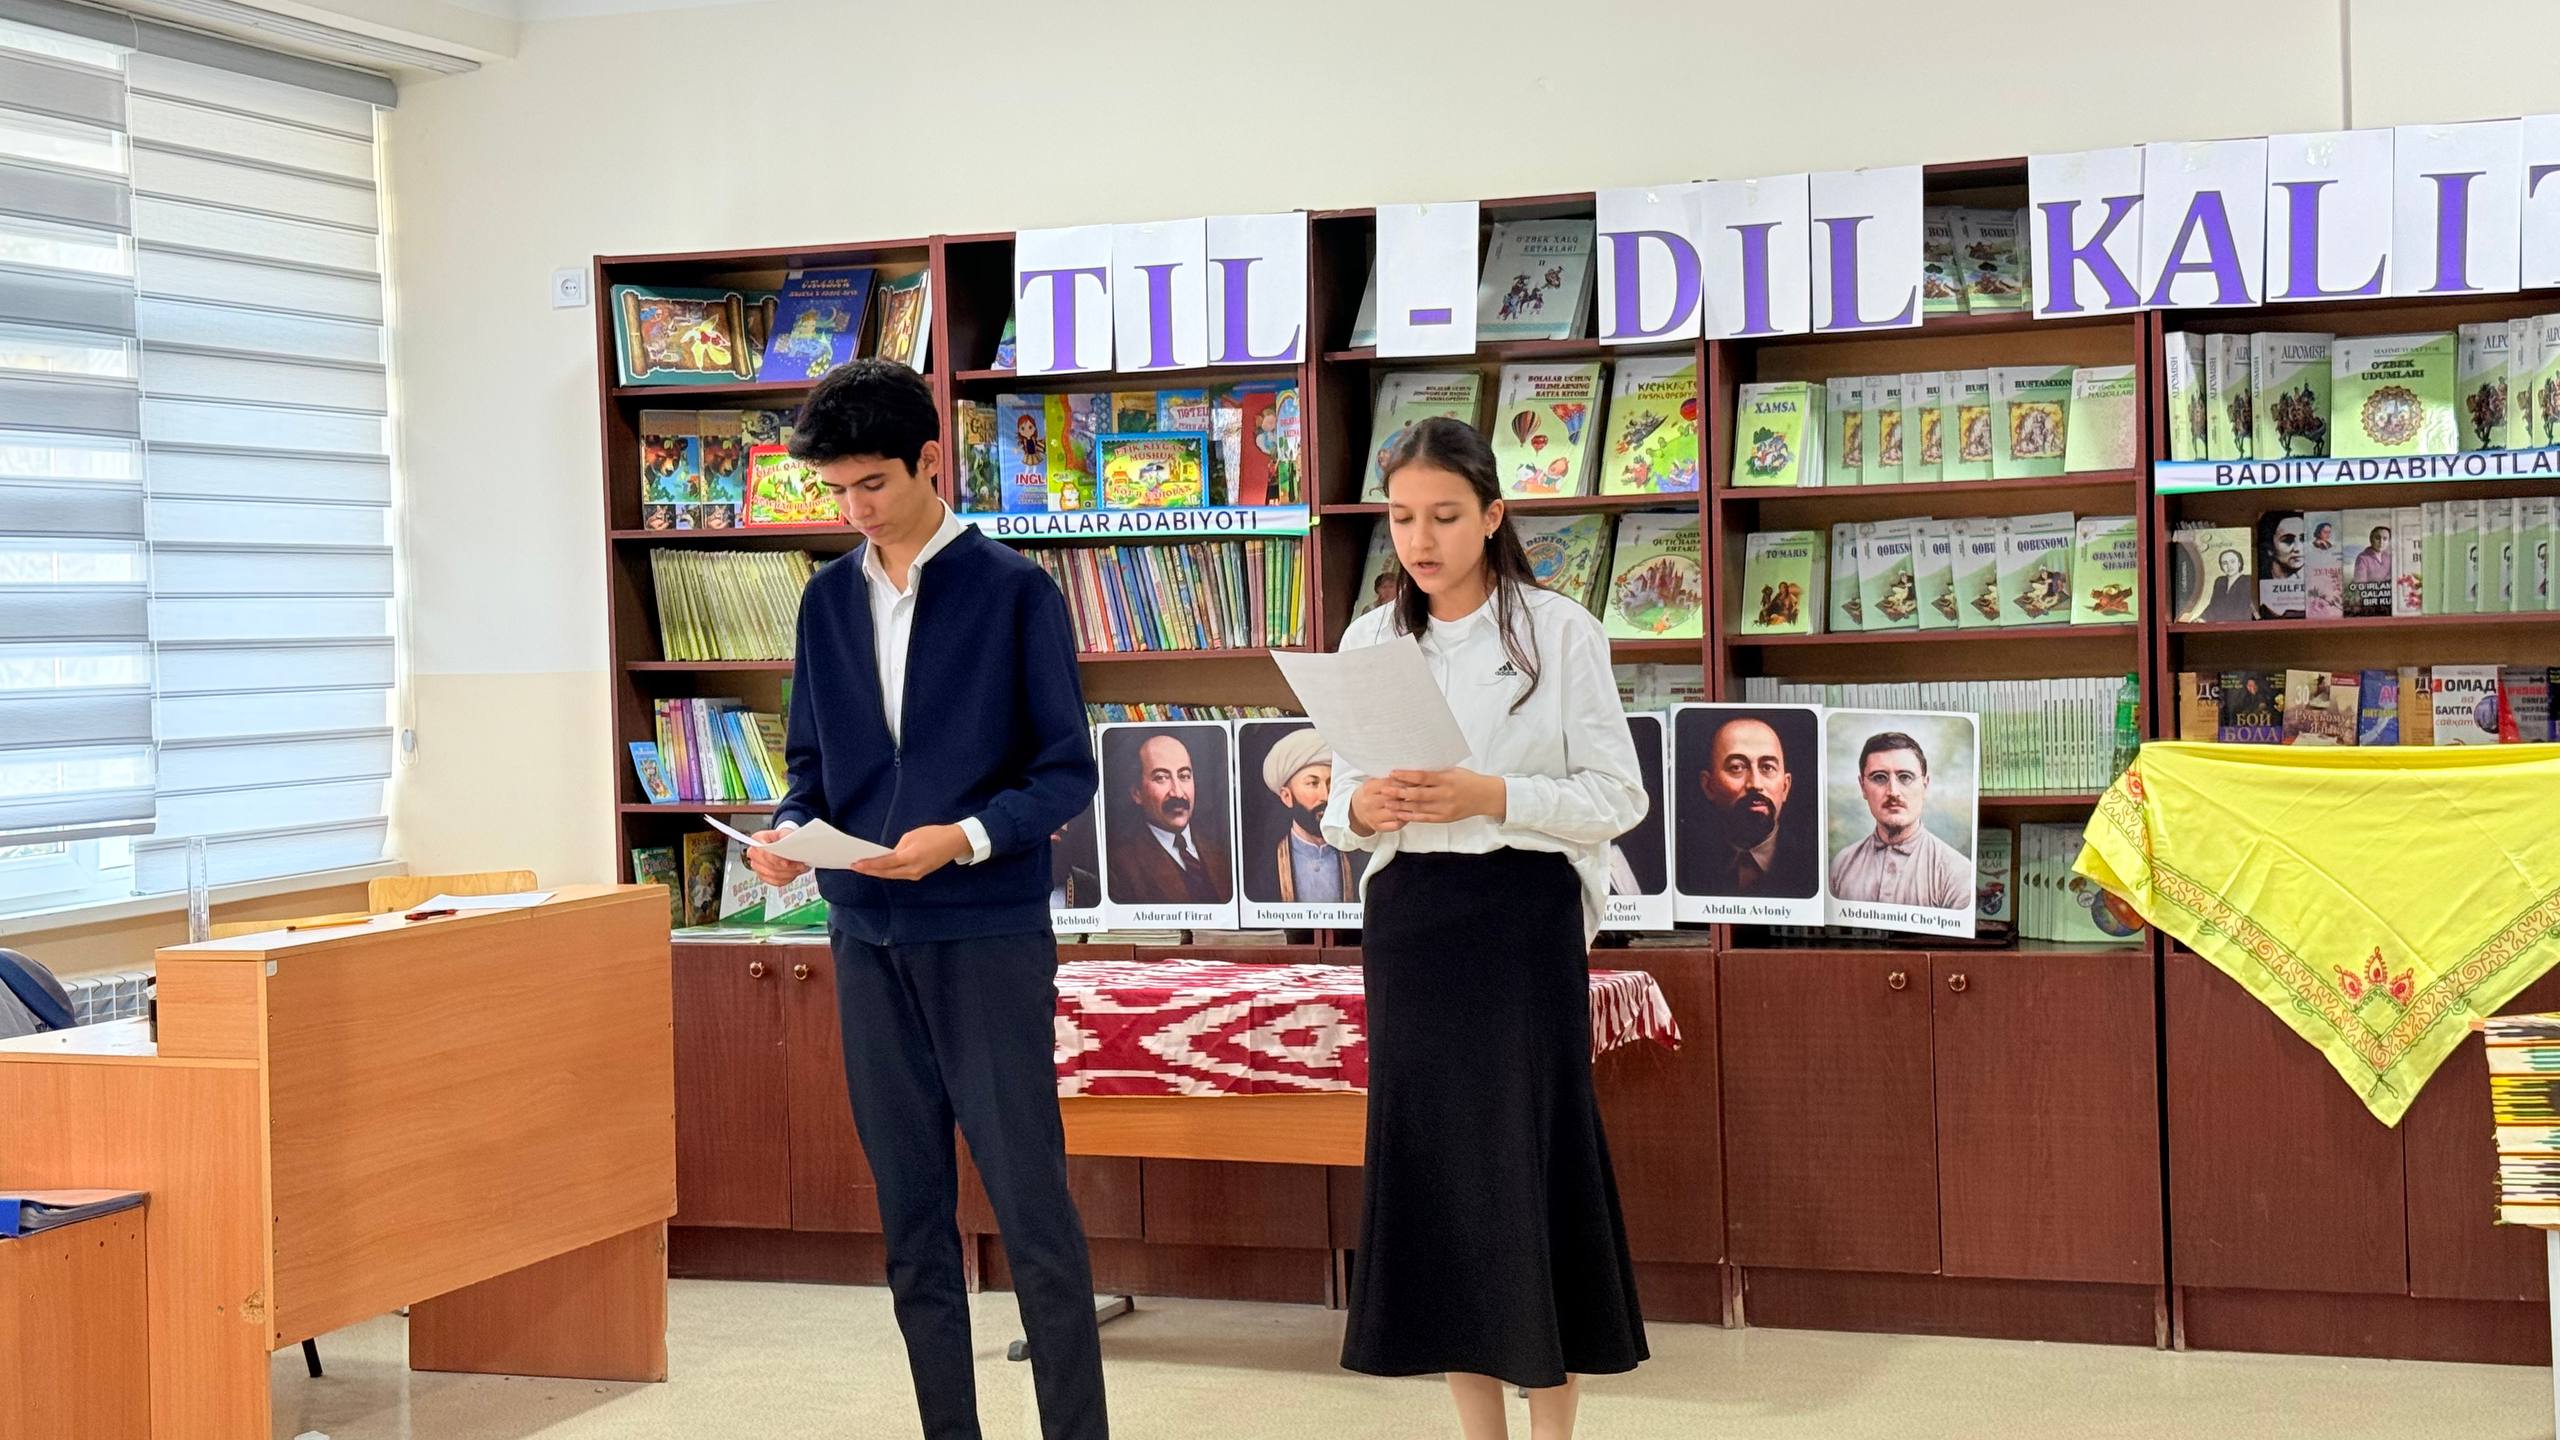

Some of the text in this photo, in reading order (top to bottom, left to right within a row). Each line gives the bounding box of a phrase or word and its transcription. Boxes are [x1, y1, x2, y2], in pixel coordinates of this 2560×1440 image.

[1020, 257, 1300, 371] TIL
[1599, 215, 1917, 339] DIL
[2281, 345, 2326, 360] ALPOMISH
[2361, 369, 2425, 381] UDUMLARI
[1755, 401, 1797, 414] XAMSA
[2216, 451, 2560, 486] BADIIY ADABIYOTLA
[997, 510, 1257, 535] BOLALAR ADABIYOTI
[2017, 536, 2069, 553] QOBUSNOMA
[2444, 679, 2496, 693] ОМАД
[2435, 706, 2473, 715] БАХТГА
[2236, 711, 2272, 726] БОЙ
[2223, 726, 2279, 742] БОЛА
[1613, 902, 1636, 912] Qori
[1702, 904, 1791, 918] Abdulla Avloniy
[1057, 916, 1100, 926] Behbudiy
[1133, 911, 1212, 921] Abdurauf Fitrat
[1257, 909, 1303, 921] Ishoqxon
[1839, 907, 1907, 922] Abdulhamid
